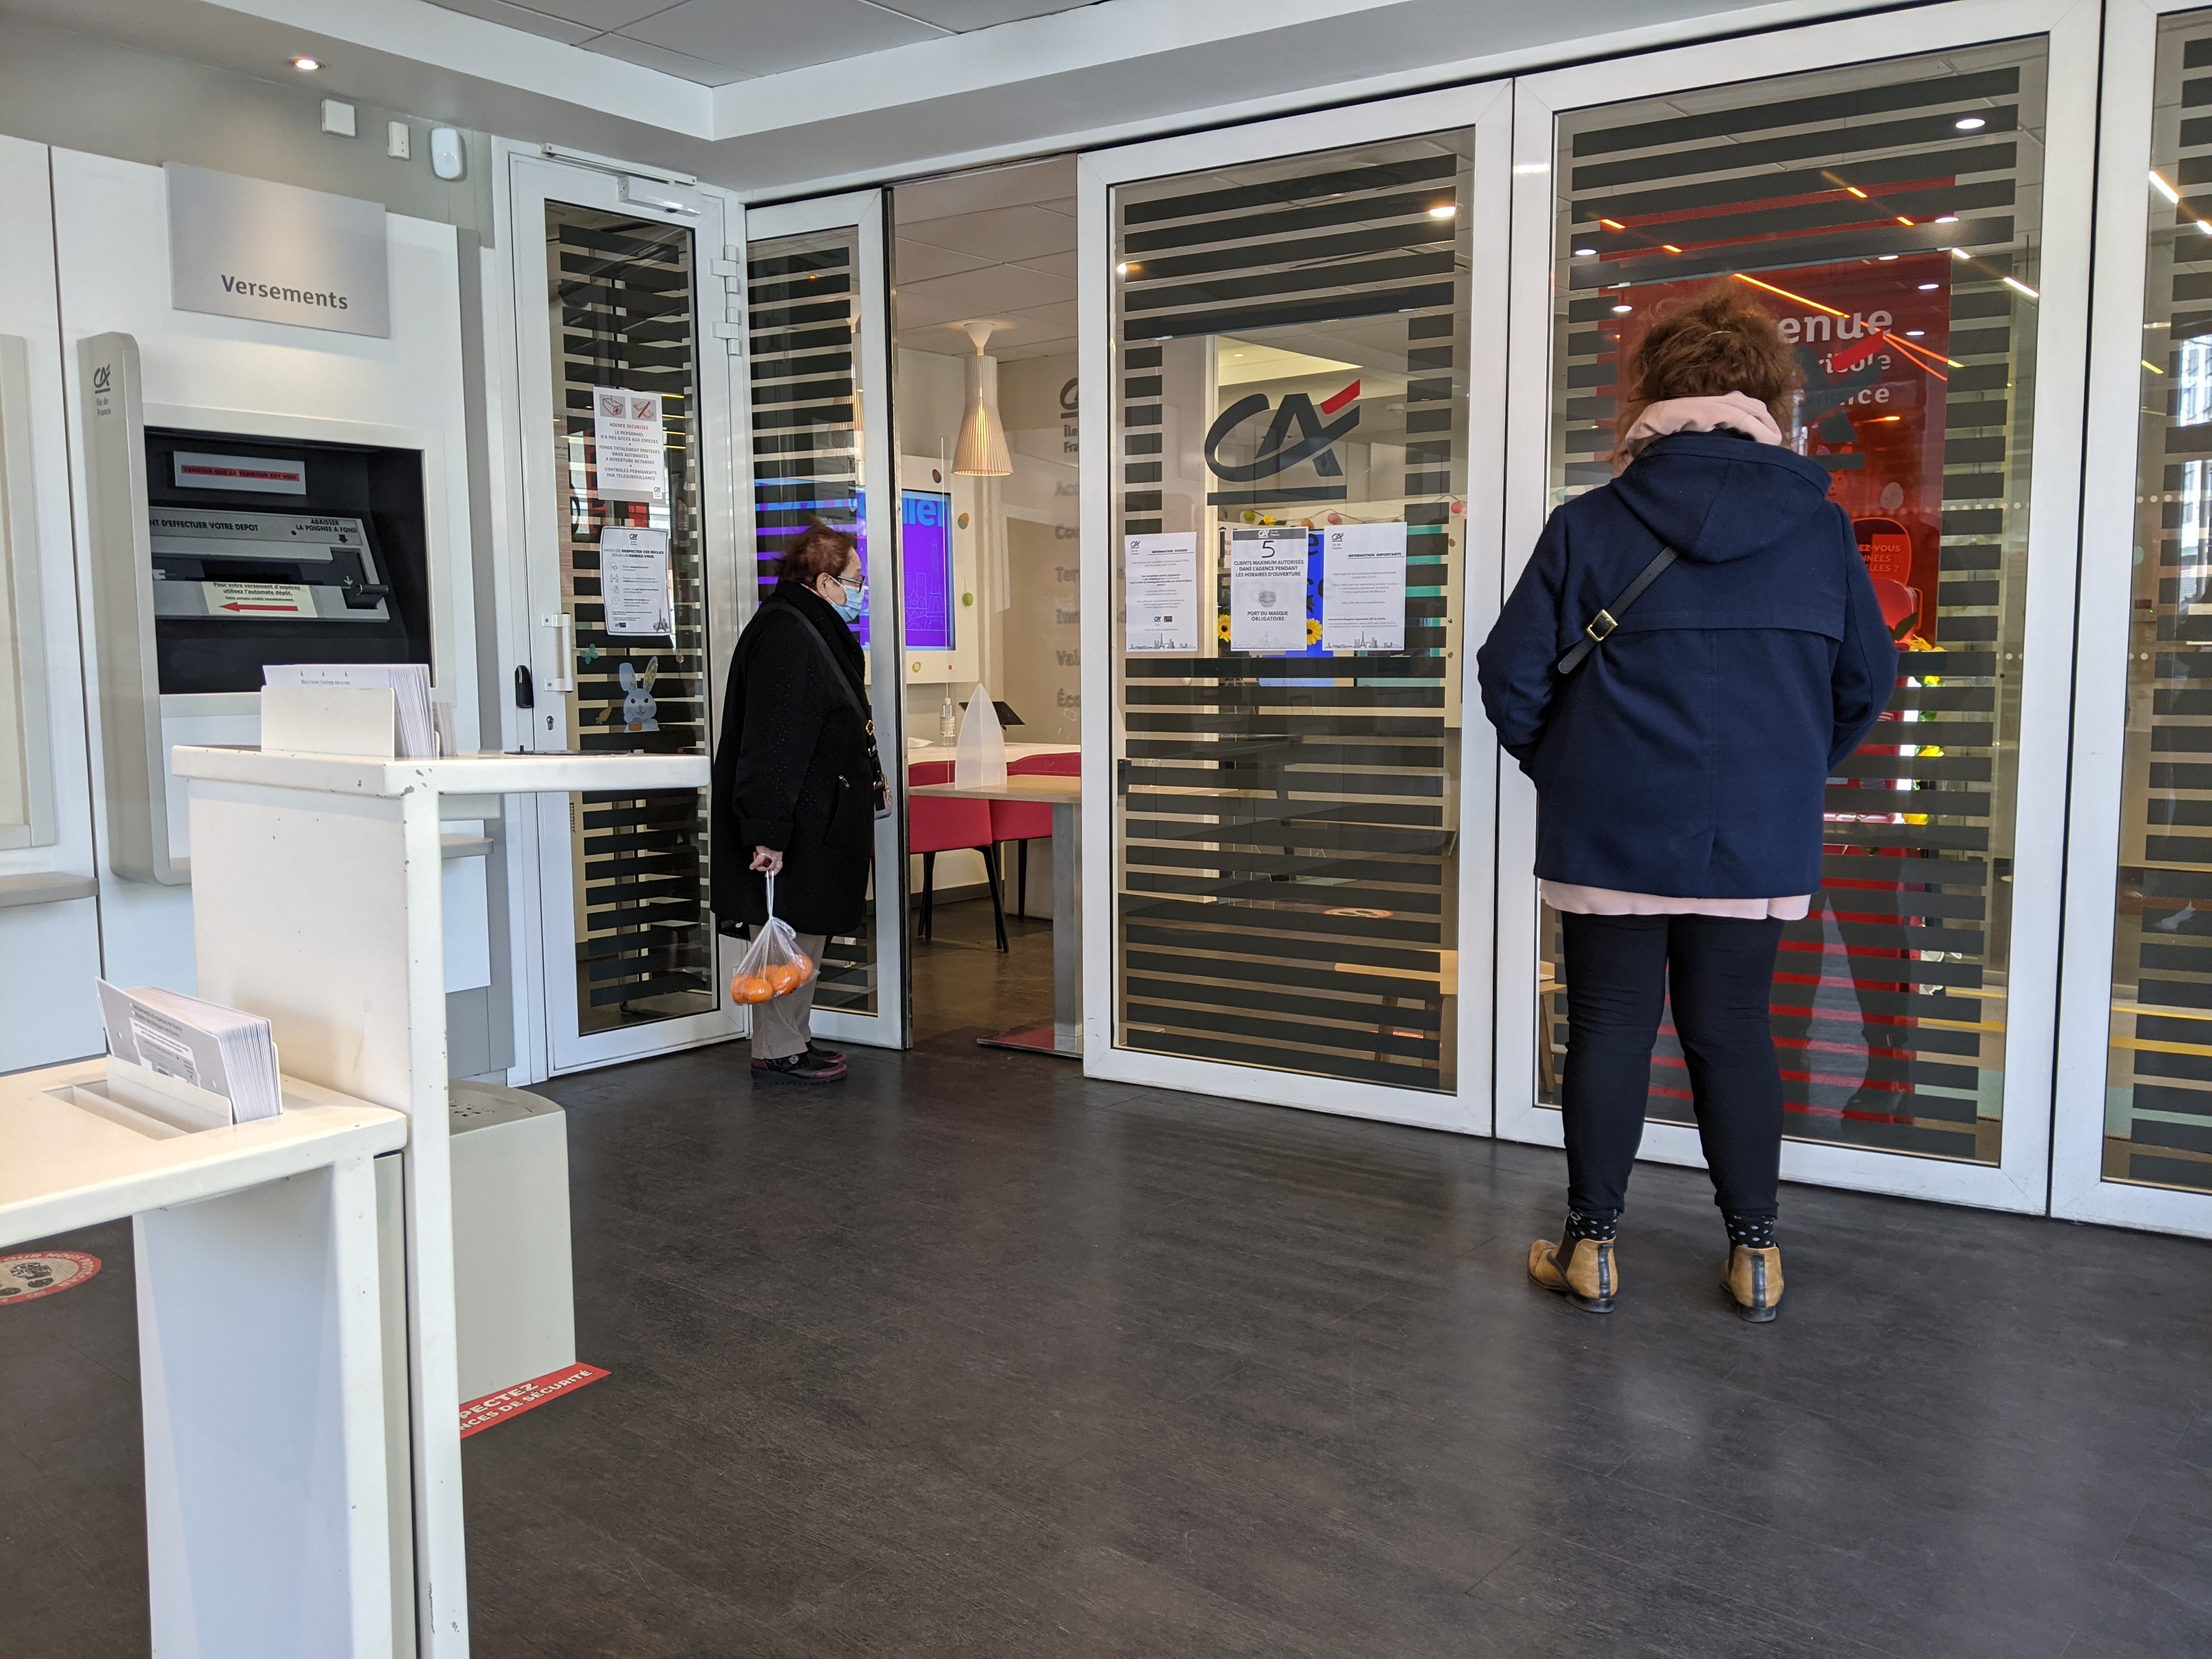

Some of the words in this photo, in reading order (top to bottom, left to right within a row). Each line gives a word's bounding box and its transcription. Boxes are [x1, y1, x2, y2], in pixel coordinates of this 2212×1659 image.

[221, 274, 348, 309] Versements
[161, 520, 208, 529] D'EFFECTUER
[209, 522, 234, 530] VOTRE
[1262, 540, 1275, 558] 5
[0, 1254, 42, 1262] OUR
[498, 1401, 524, 1412] DE
[522, 1370, 593, 1402] SÉCURITÉ
